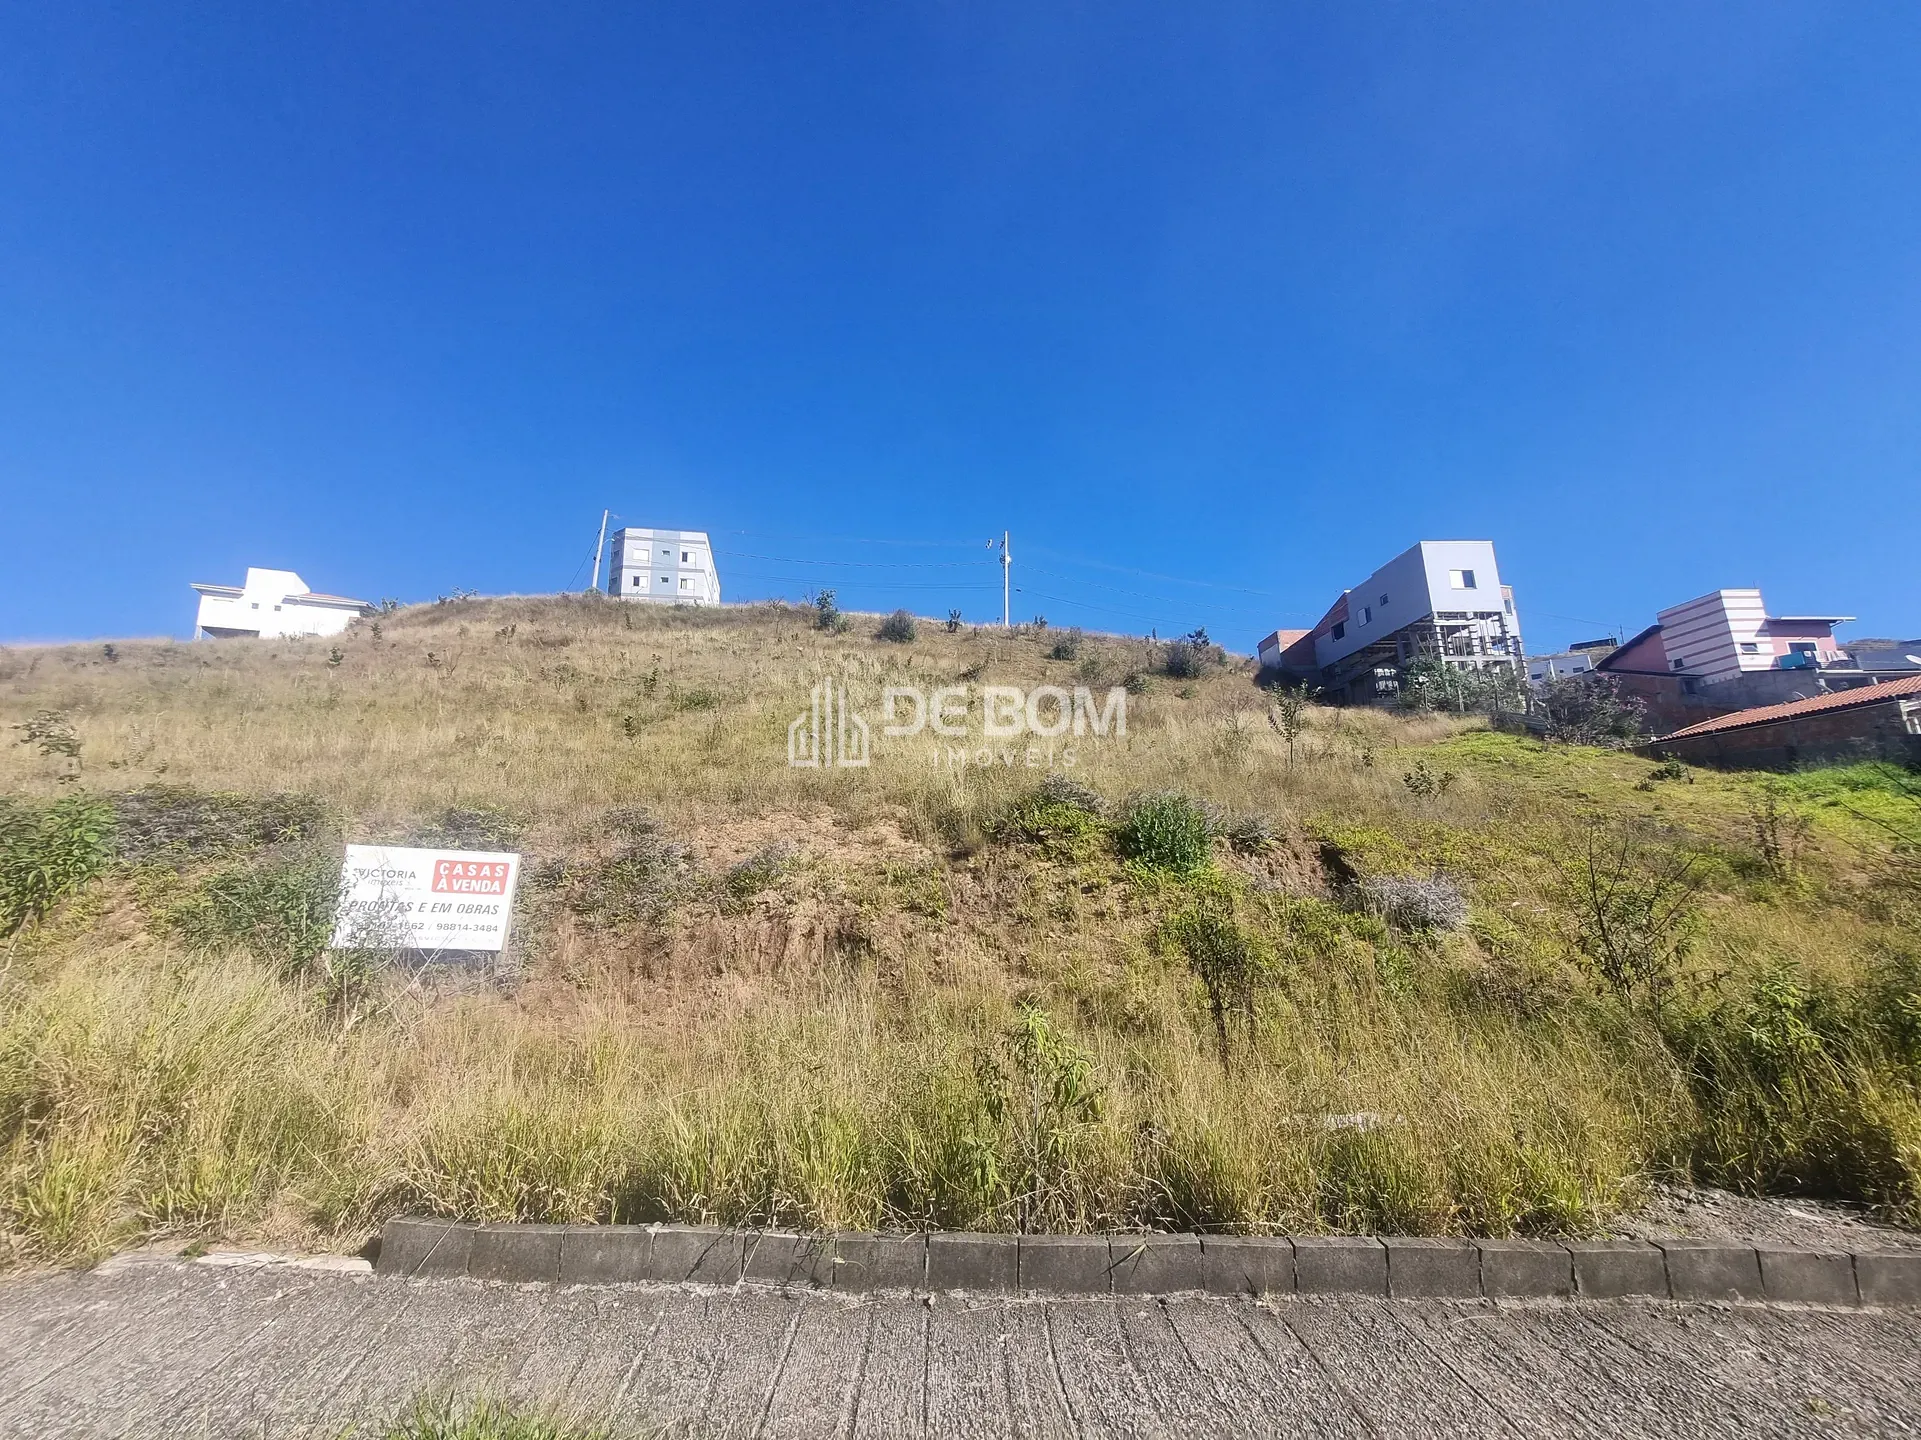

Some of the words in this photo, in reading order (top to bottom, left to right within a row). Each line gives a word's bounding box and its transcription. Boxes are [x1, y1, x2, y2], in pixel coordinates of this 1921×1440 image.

[439, 863, 505, 877] CASAS
[452, 879, 501, 893] VENDA
[418, 902, 427, 913] E
[431, 902, 452, 914] EM
[456, 903, 500, 915] OBRAS
[436, 922, 499, 932] 98814-3484
